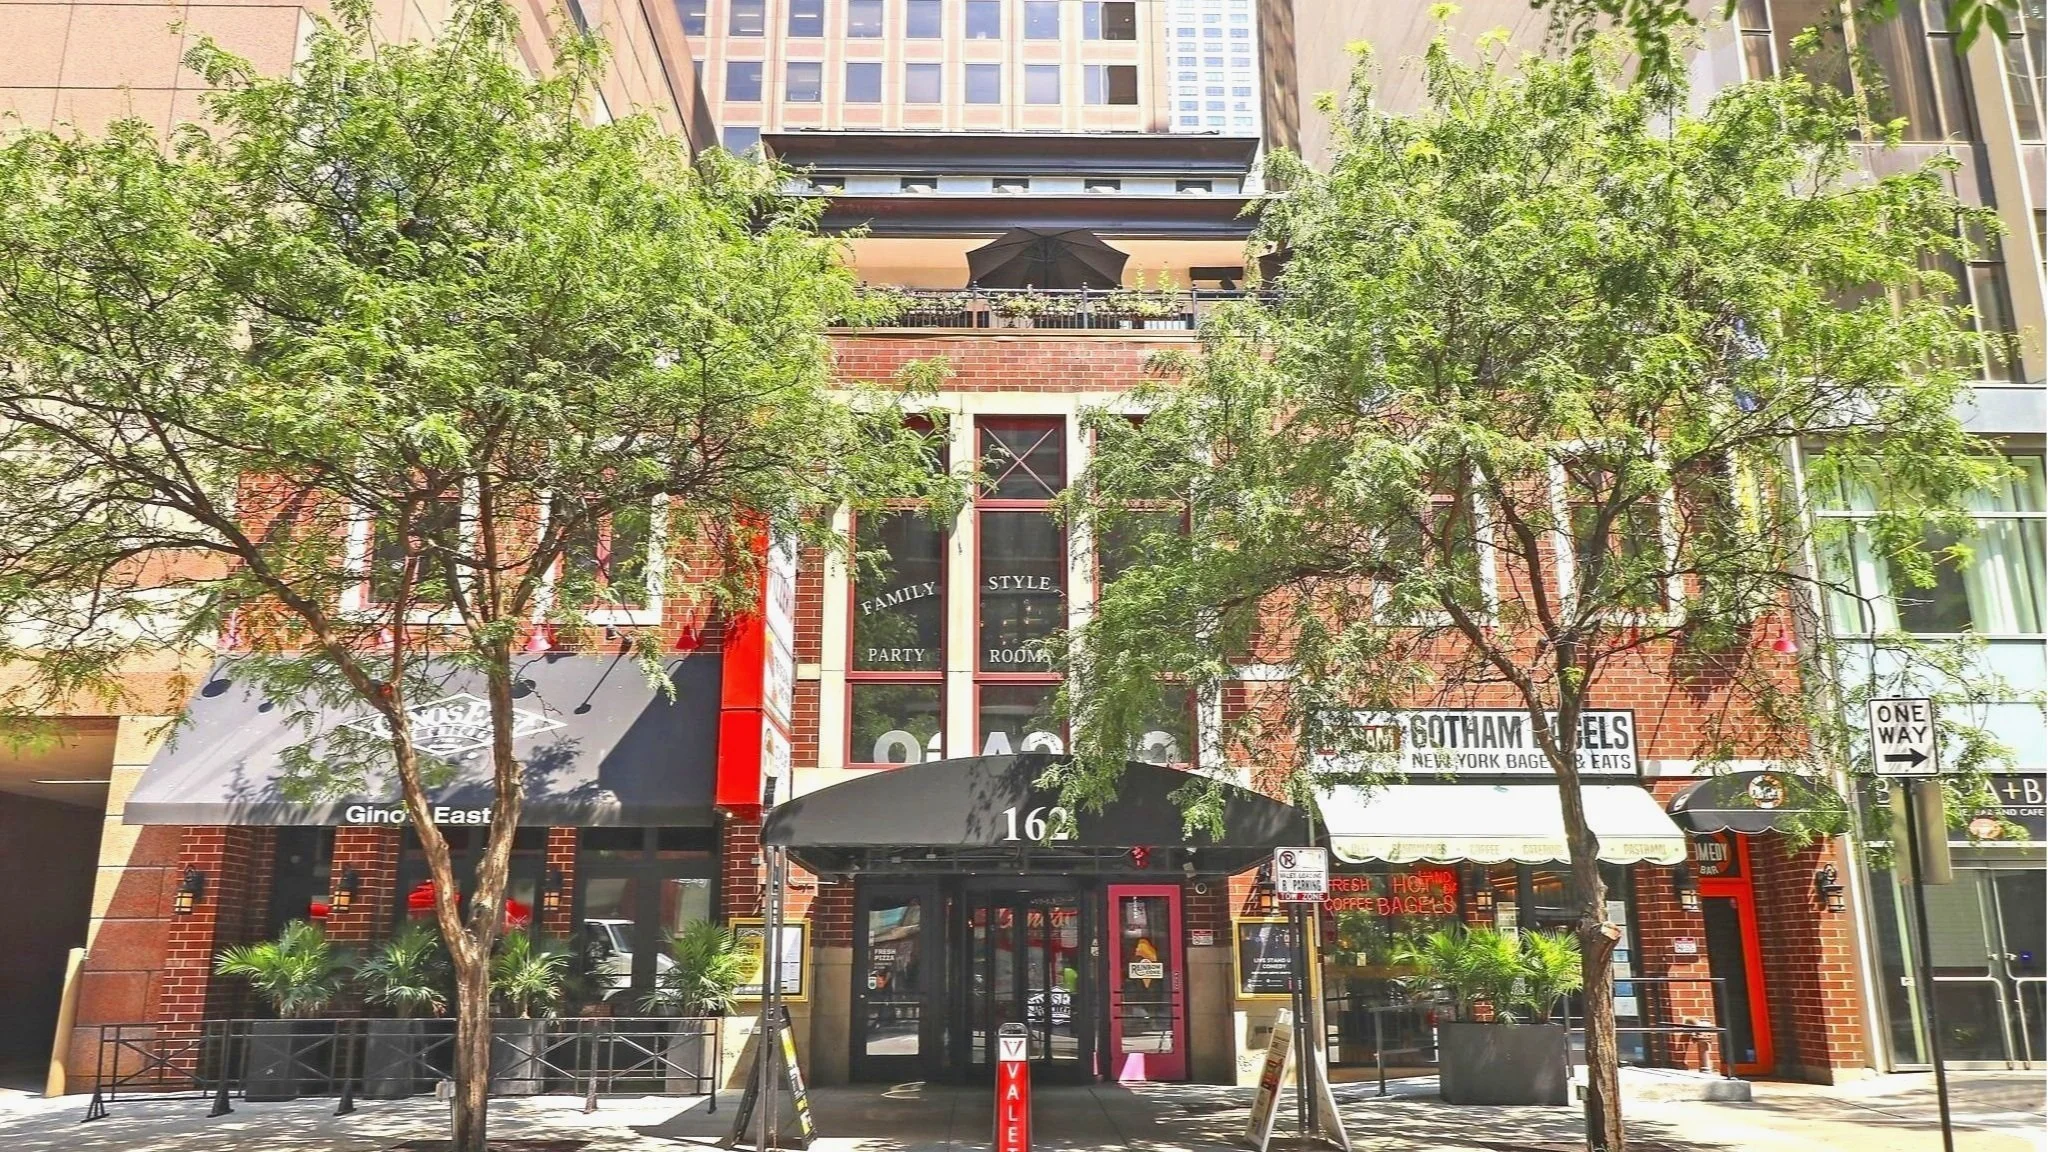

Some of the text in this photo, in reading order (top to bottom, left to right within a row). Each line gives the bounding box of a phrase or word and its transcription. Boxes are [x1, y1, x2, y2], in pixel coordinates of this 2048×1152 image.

[861, 576, 1051, 616] FAMILY STYLE
[868, 648, 925, 662] PARTY
[1877, 705, 1925, 722] ONE
[1410, 715, 1523, 749] GOTHAM
[1878, 726, 1927, 743] WAY
[1456, 754, 1500, 769] YORK
[1592, 754, 1631, 769] EATS
[434, 806, 491, 824] East
[2019, 808, 2046, 816] CAFE
[1002, 805, 1069, 841] 162
[1700, 866, 1719, 876] BAR
[1328, 878, 1370, 892] FRESH
[1323, 897, 1374, 912] COFFEE
[1376, 895, 1457, 916] BAGELS
